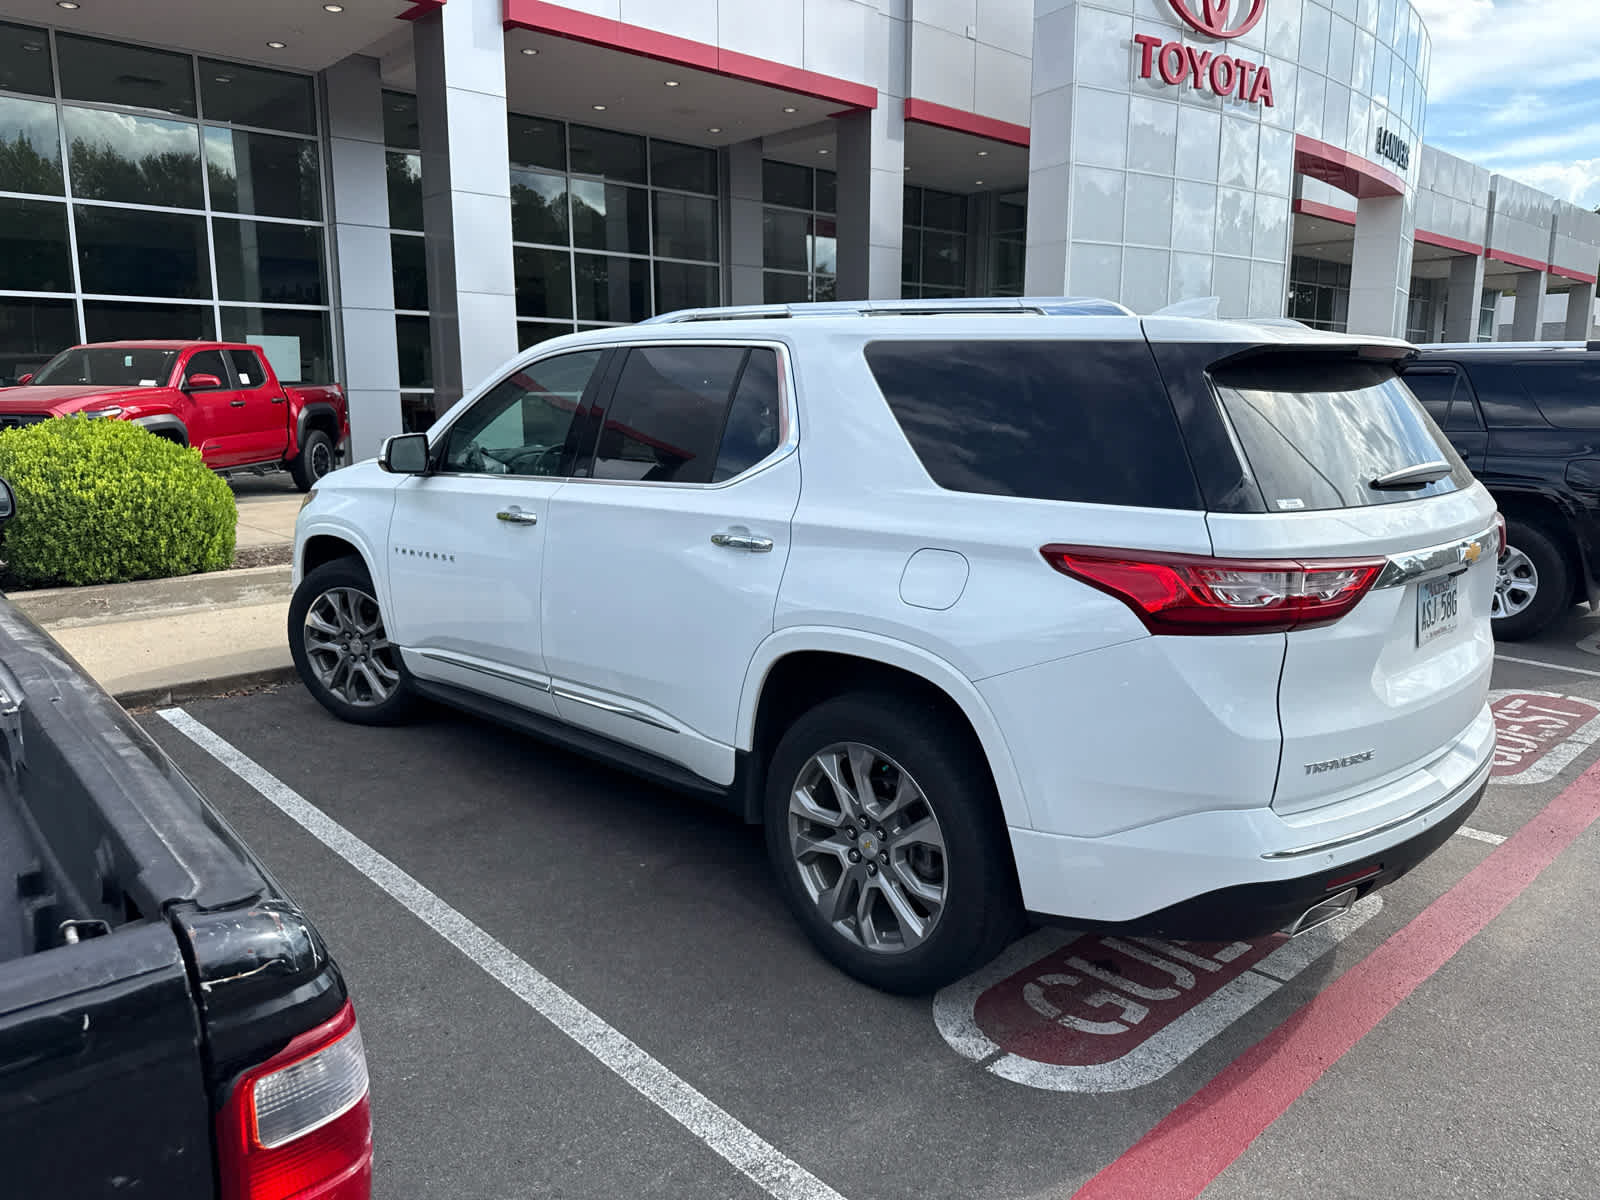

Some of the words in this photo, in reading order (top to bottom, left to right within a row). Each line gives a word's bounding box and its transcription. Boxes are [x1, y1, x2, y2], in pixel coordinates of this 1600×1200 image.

[1134, 33, 1274, 108] TOYOTA
[395, 546, 455, 563] TRAVERSE
[1304, 750, 1376, 775] TRAVERSE
